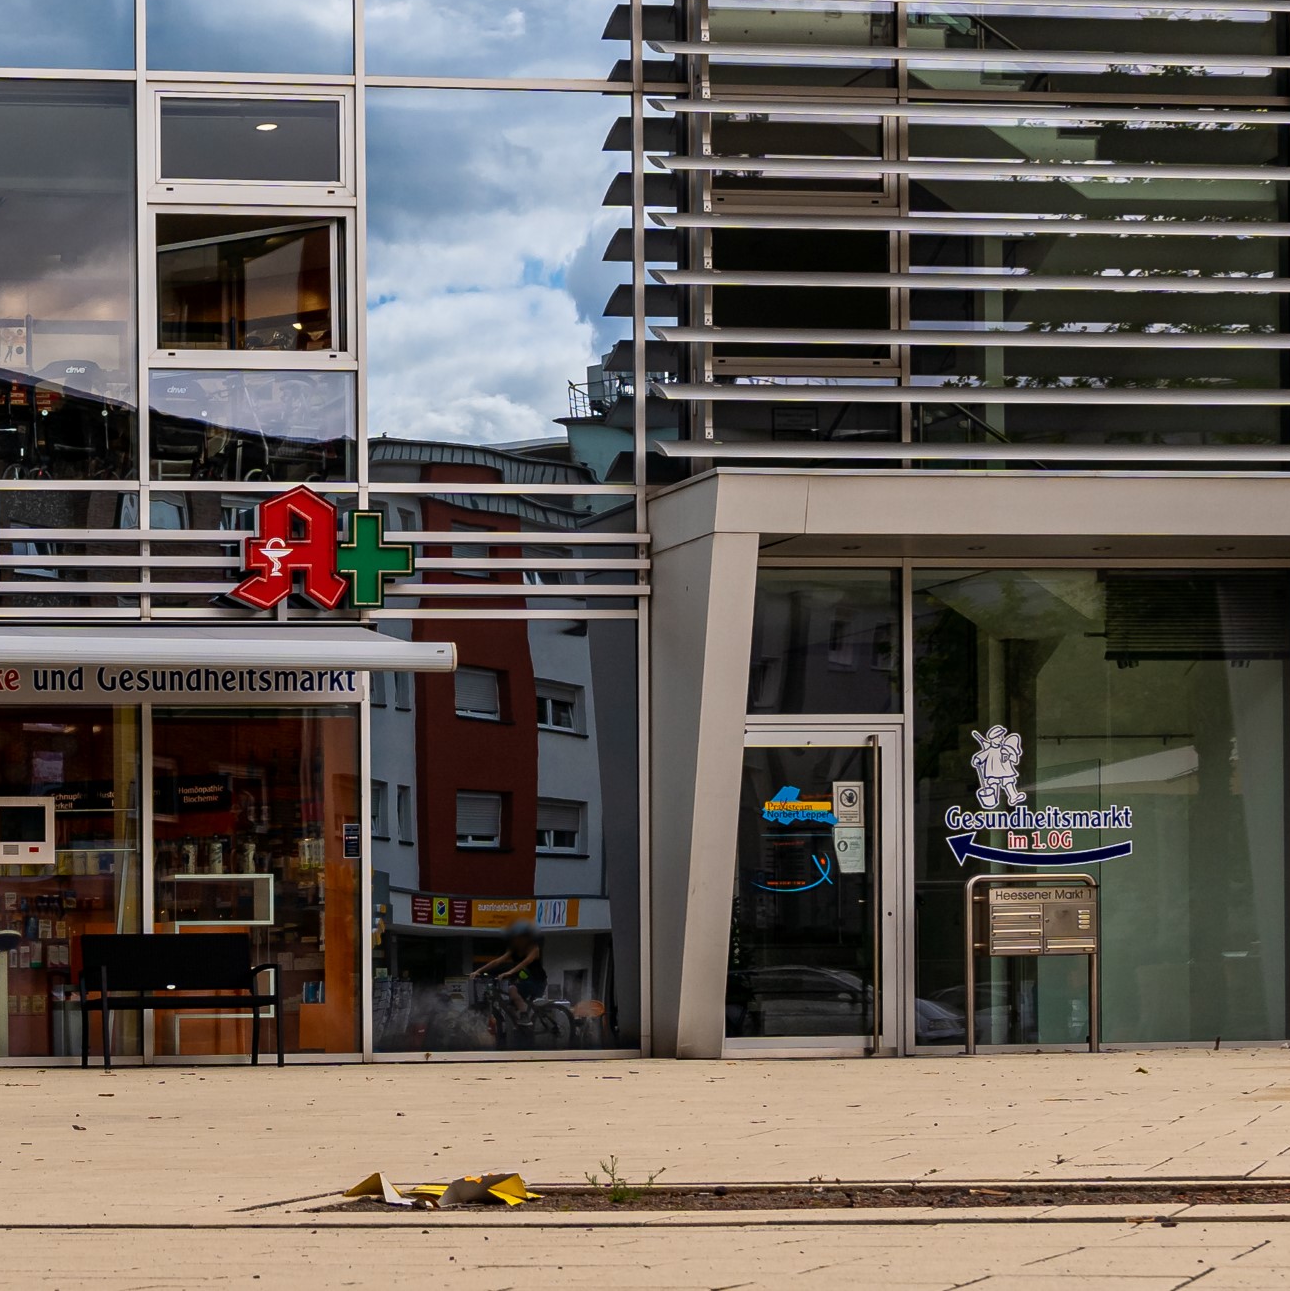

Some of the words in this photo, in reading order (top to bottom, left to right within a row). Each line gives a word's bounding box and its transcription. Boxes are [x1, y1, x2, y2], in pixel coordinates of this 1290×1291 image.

[65, 365, 86, 374] drive
[166, 385, 187, 394] drive
[33, 666, 84, 692] und
[96, 666, 357, 693] Gesundheitsmarkt
[178, 784, 224, 794] Homöopathie
[183, 794, 219, 803] Biochemie
[767, 811, 799, 819] Norbert
[802, 811, 830, 820] Lepper
[945, 804, 1133, 830] Gesundheitsmarkt
[1007, 830, 1028, 849] im
[995, 890, 1052, 900] Heessener
[1054, 889, 1083, 899] Markt
[1087, 889, 1092, 899] 1
